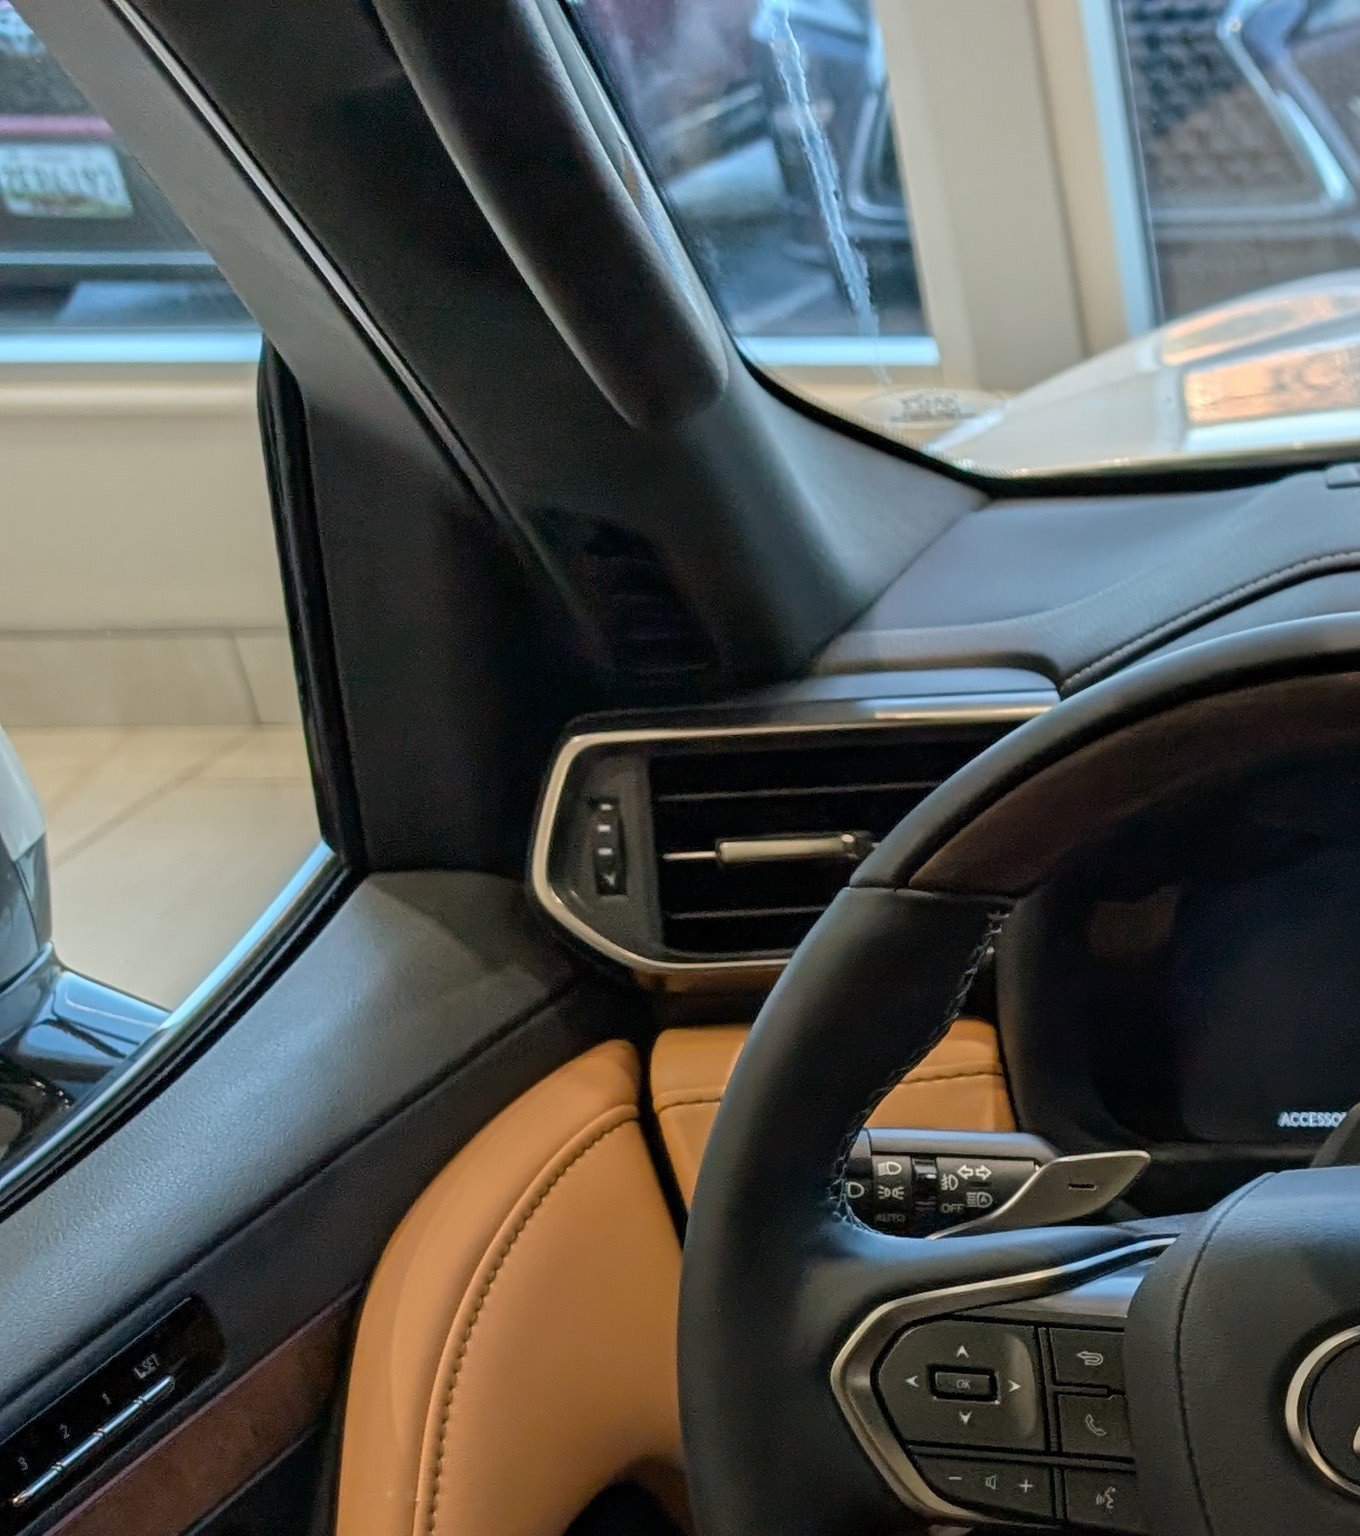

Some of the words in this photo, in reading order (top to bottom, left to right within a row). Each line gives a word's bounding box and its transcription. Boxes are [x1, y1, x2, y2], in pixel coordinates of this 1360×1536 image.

[1277, 1111, 1347, 1127] ACCESSO
[941, 1203, 964, 1213] OFF
[957, 1379, 971, 1388] OK
